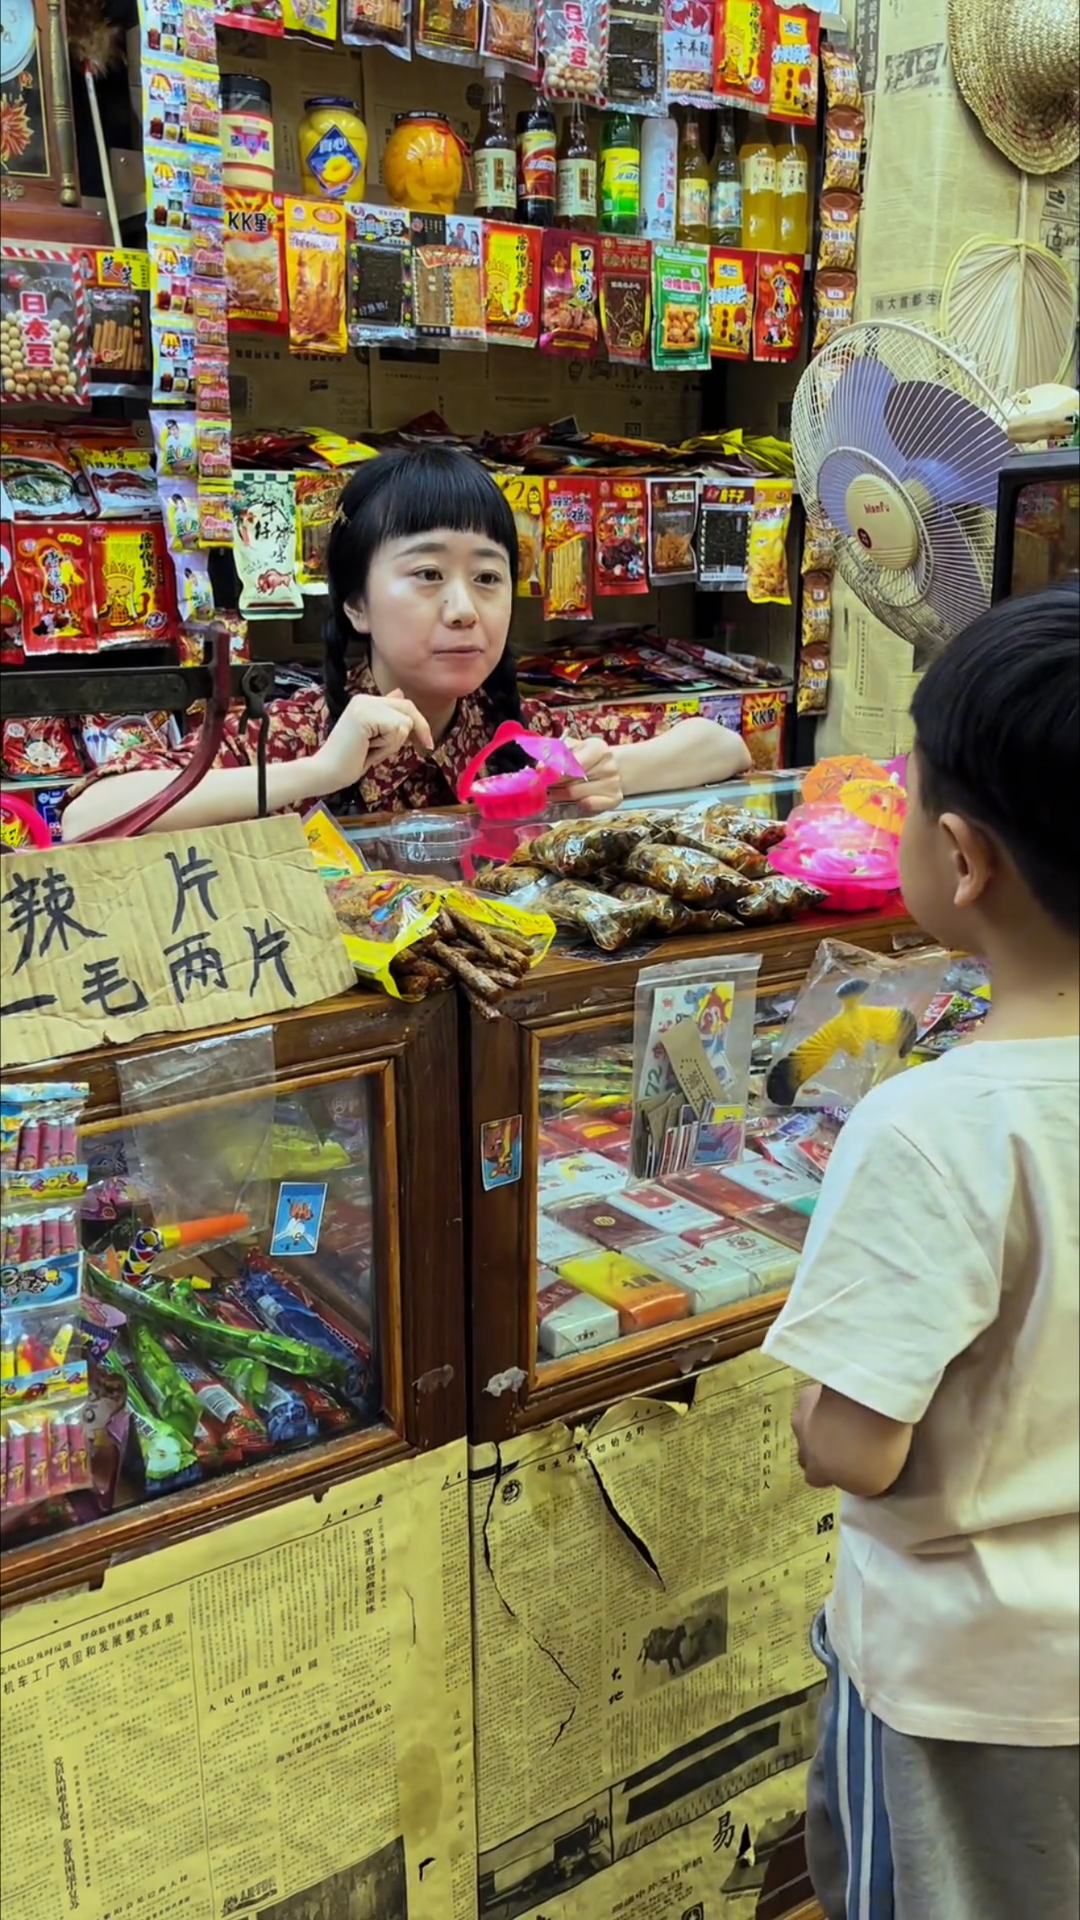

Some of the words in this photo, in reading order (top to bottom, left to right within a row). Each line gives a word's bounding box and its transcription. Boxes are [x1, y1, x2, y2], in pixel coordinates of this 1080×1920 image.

[563, 2, 590, 68] 日本豆
[228, 210, 267, 232] KK星
[20, 291, 55, 367] 日本豆
[0, 845, 219, 976] 辣片
[0, 918, 299, 1017] 一毛两片
[3, 1612, 175, 1696] 机车工厂巩固和发展整党成果
[711, 1810, 738, 1850] 易
